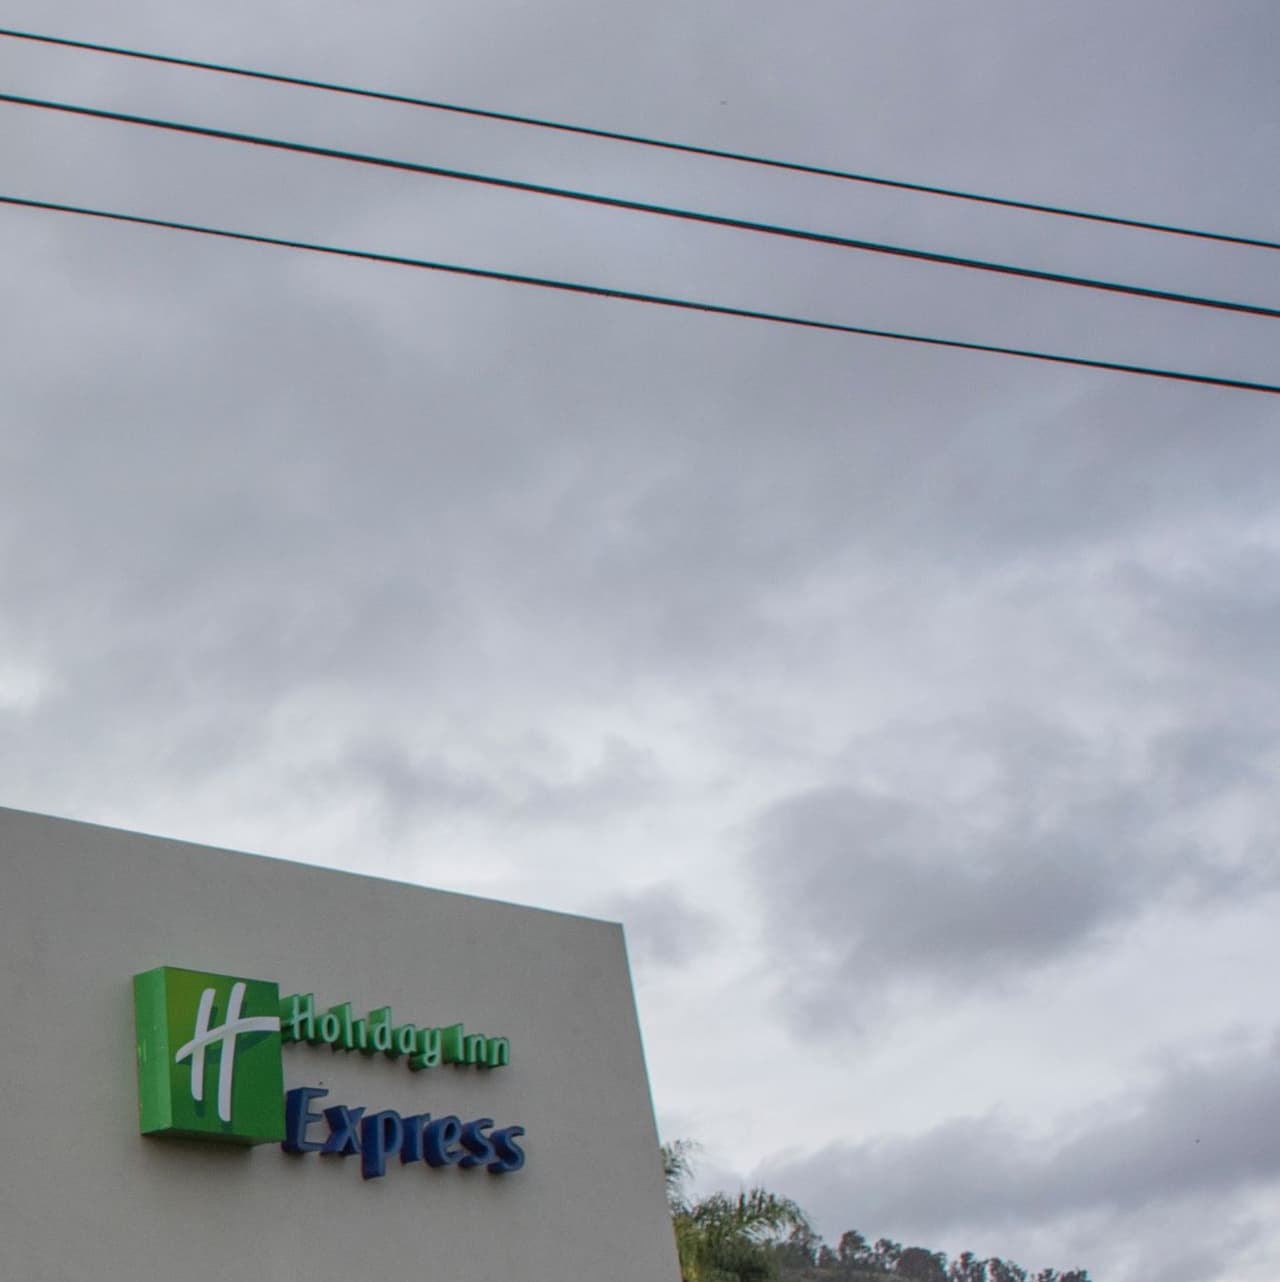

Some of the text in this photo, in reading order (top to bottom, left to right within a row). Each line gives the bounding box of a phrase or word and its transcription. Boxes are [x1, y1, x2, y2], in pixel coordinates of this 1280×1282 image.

[282, 993, 510, 1070] Holiday Inn
[282, 1087, 526, 1180] Express
